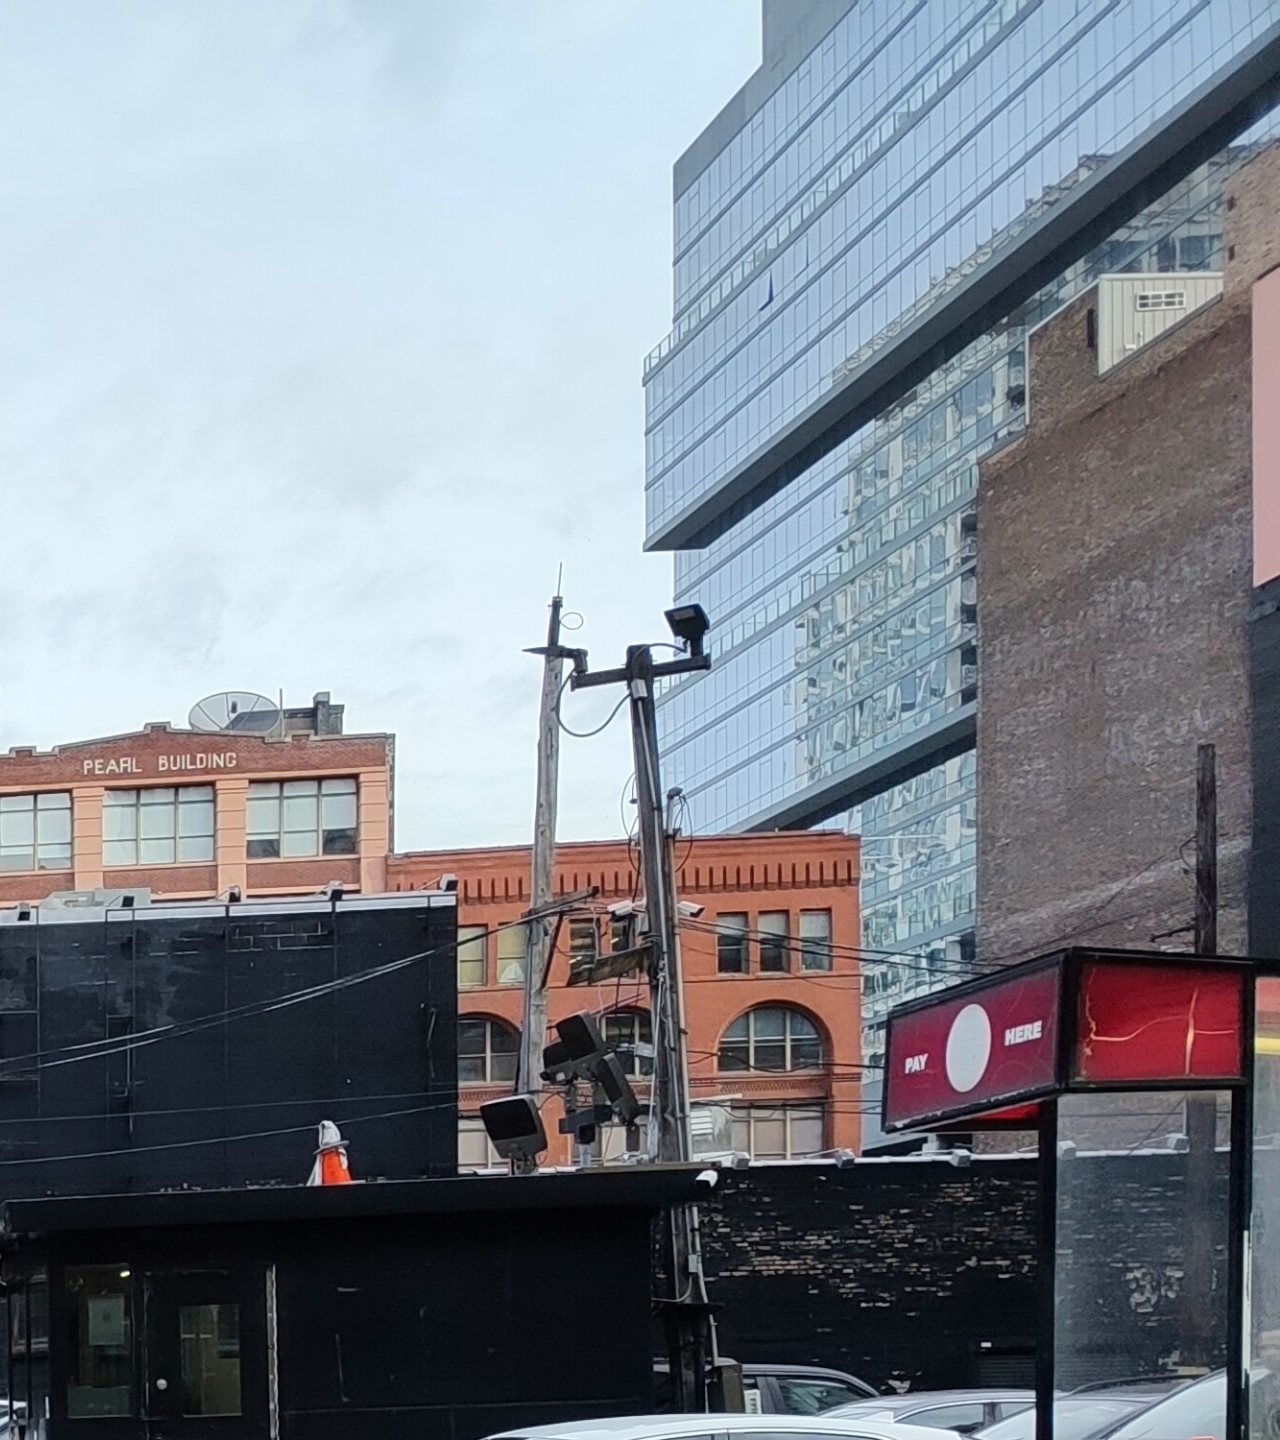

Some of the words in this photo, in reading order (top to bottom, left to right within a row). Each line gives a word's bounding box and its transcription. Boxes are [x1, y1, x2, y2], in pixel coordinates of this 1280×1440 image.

[83, 757, 143, 775] PEARL
[158, 752, 237, 771] BUILDING
[904, 1053, 929, 1074] PAY
[1004, 1020, 1043, 1046] HERE
